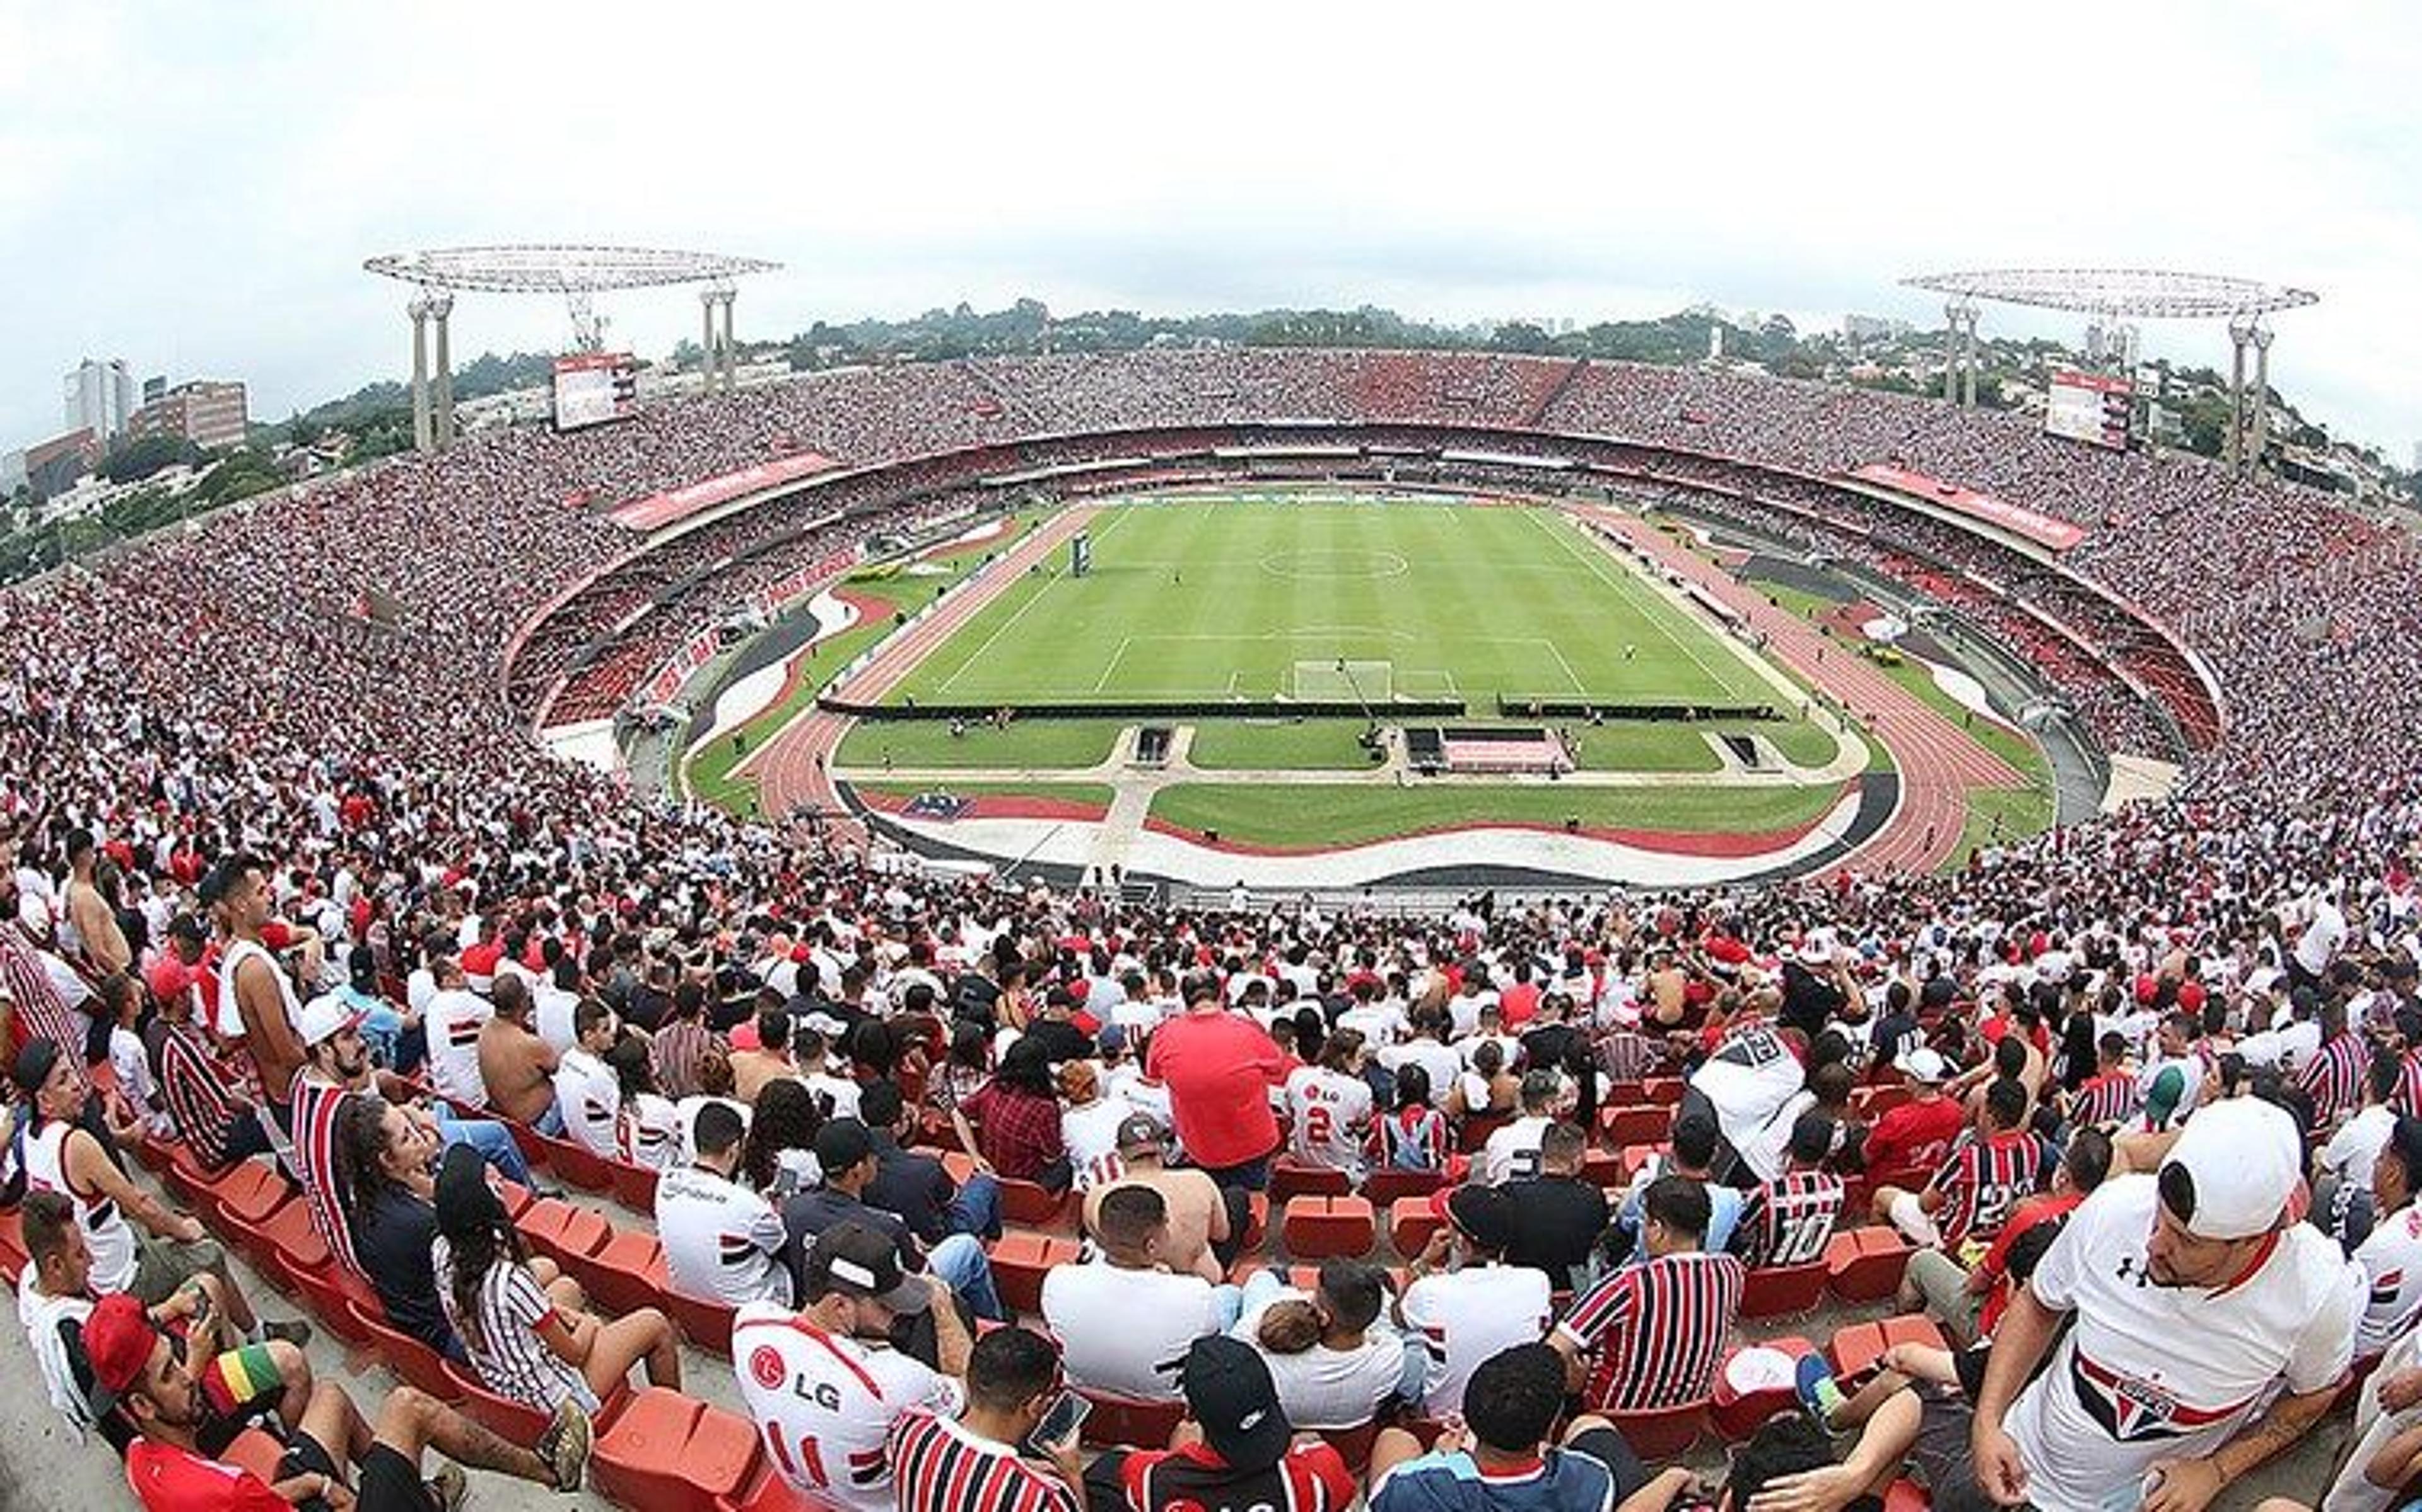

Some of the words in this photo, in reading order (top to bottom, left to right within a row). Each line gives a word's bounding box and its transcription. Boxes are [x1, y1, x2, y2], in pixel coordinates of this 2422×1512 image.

[1322, 1090, 1340, 1103] LG
[1308, 1106, 1330, 1144] 2
[1772, 1213, 1835, 1264] 10
[793, 1372, 841, 1413] LG
